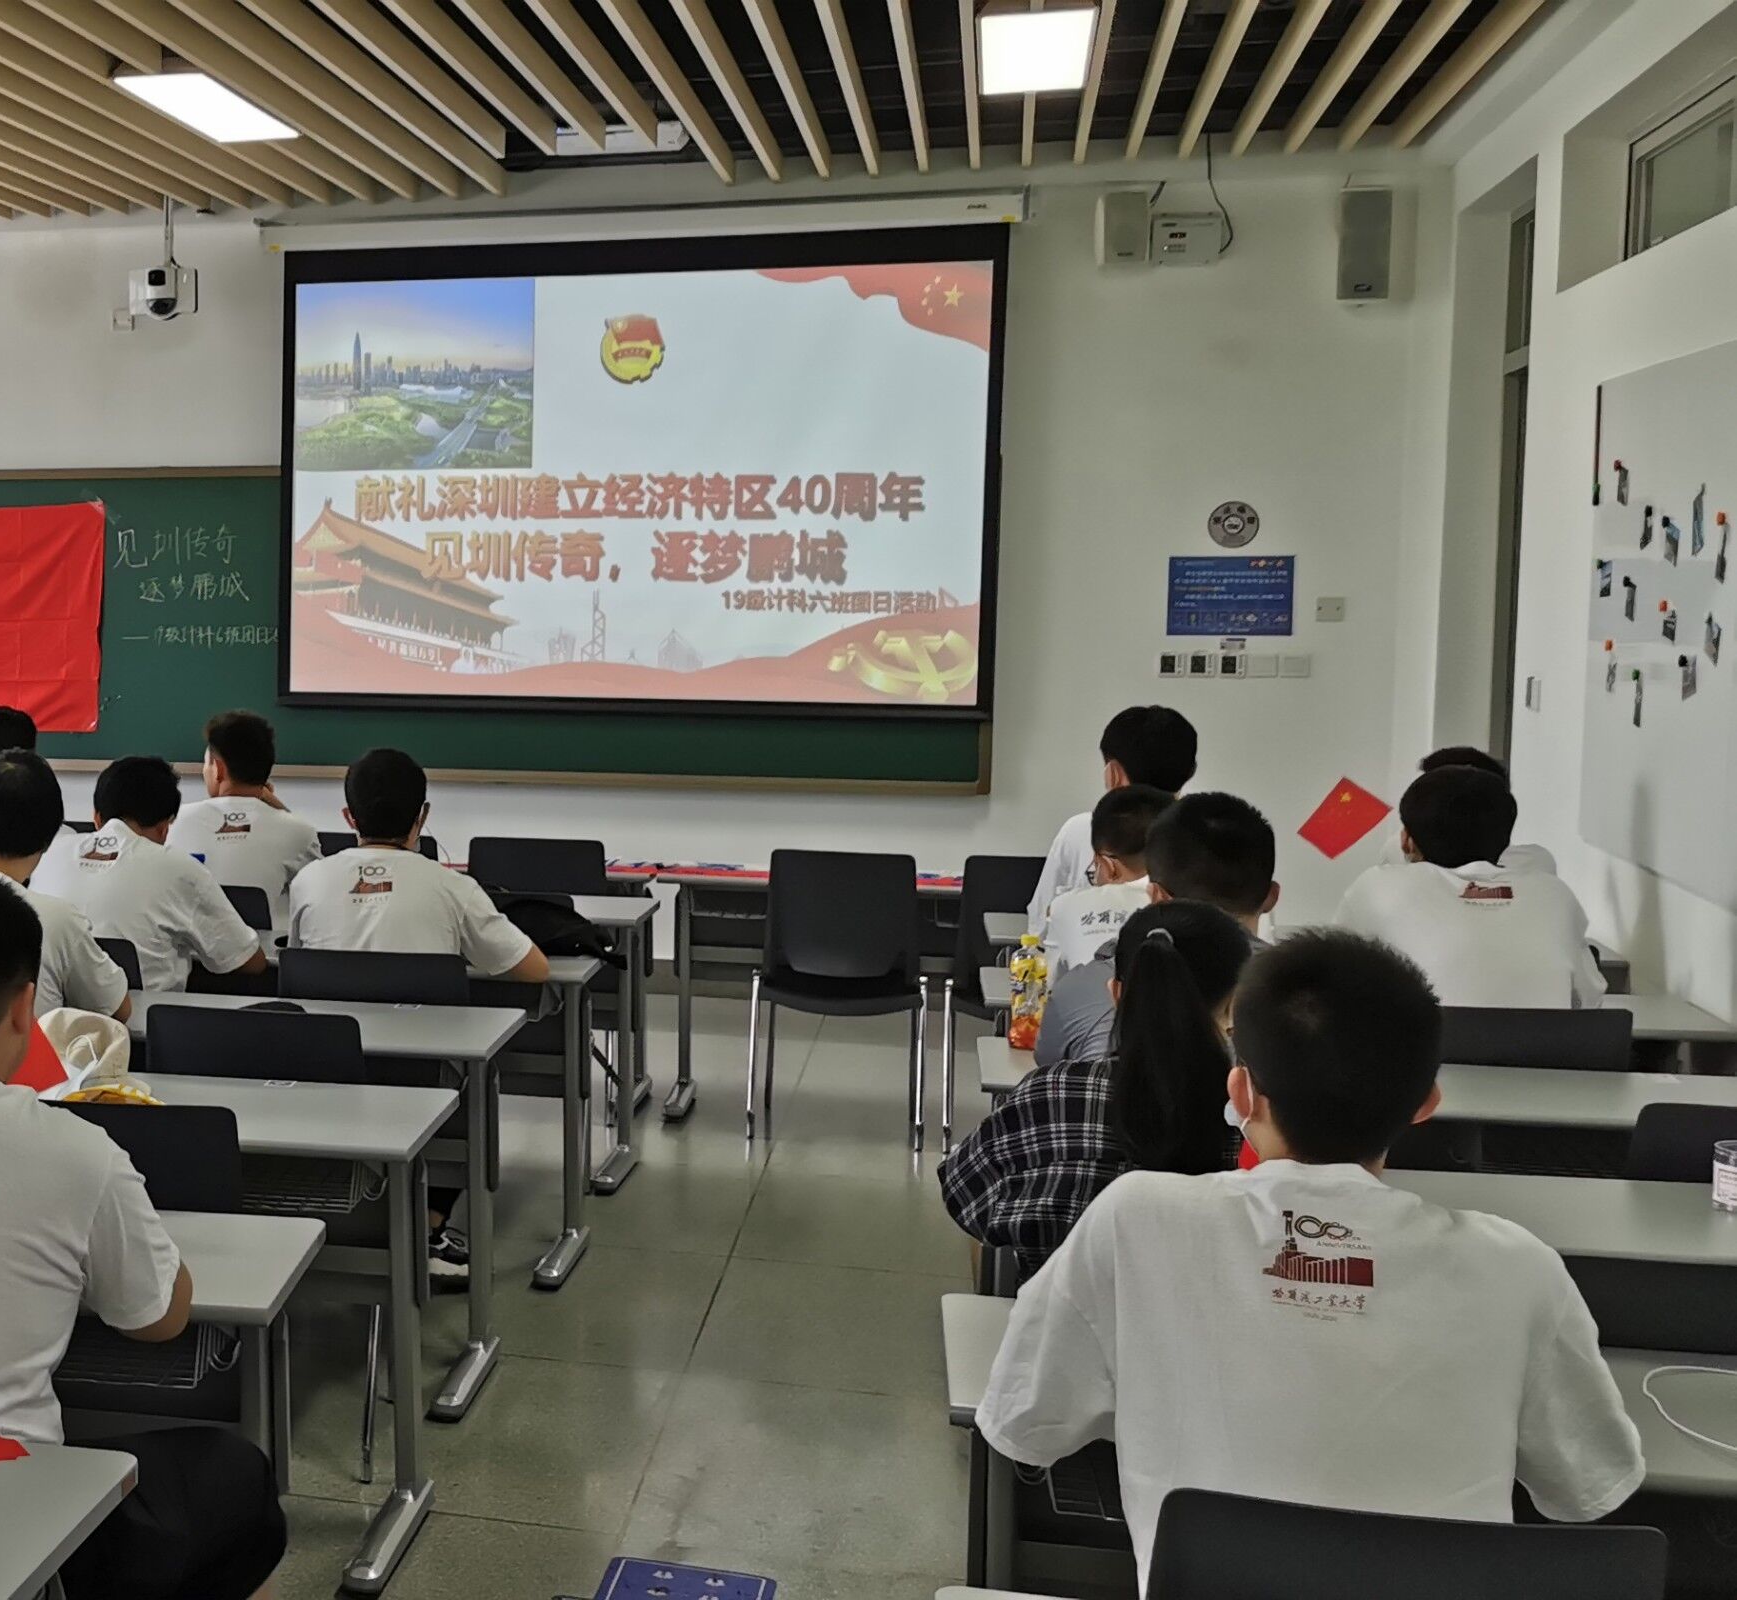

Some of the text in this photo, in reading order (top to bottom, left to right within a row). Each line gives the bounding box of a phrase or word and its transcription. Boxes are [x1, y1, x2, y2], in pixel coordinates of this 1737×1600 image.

[354, 472, 925, 522] 献礼深圳建立经济特区40周年
[114, 524, 237, 569] 见圳传奇
[139, 571, 250, 603] 逐梦鹏城
